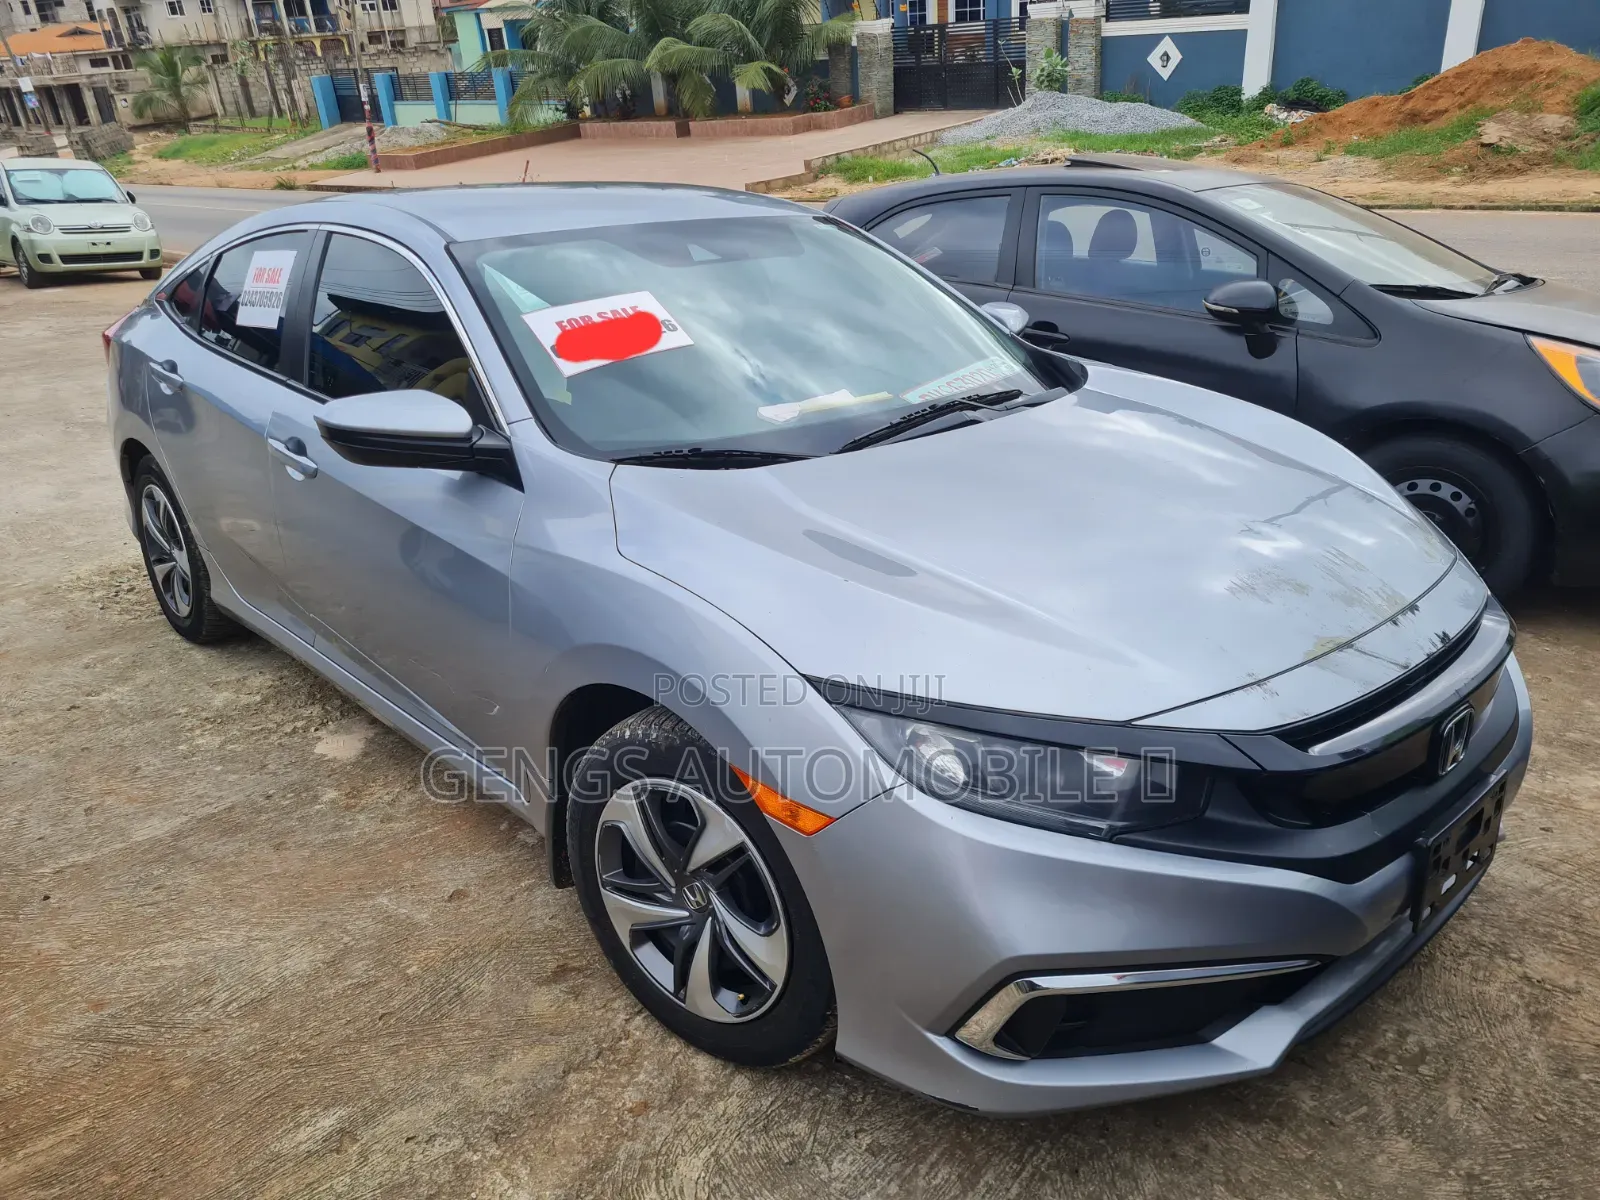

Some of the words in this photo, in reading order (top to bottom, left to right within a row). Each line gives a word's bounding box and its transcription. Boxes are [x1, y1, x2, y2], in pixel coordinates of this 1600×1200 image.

[252, 266, 267, 284] FOR
[264, 267, 283, 285] SALE
[554, 314, 596, 333] FOR
